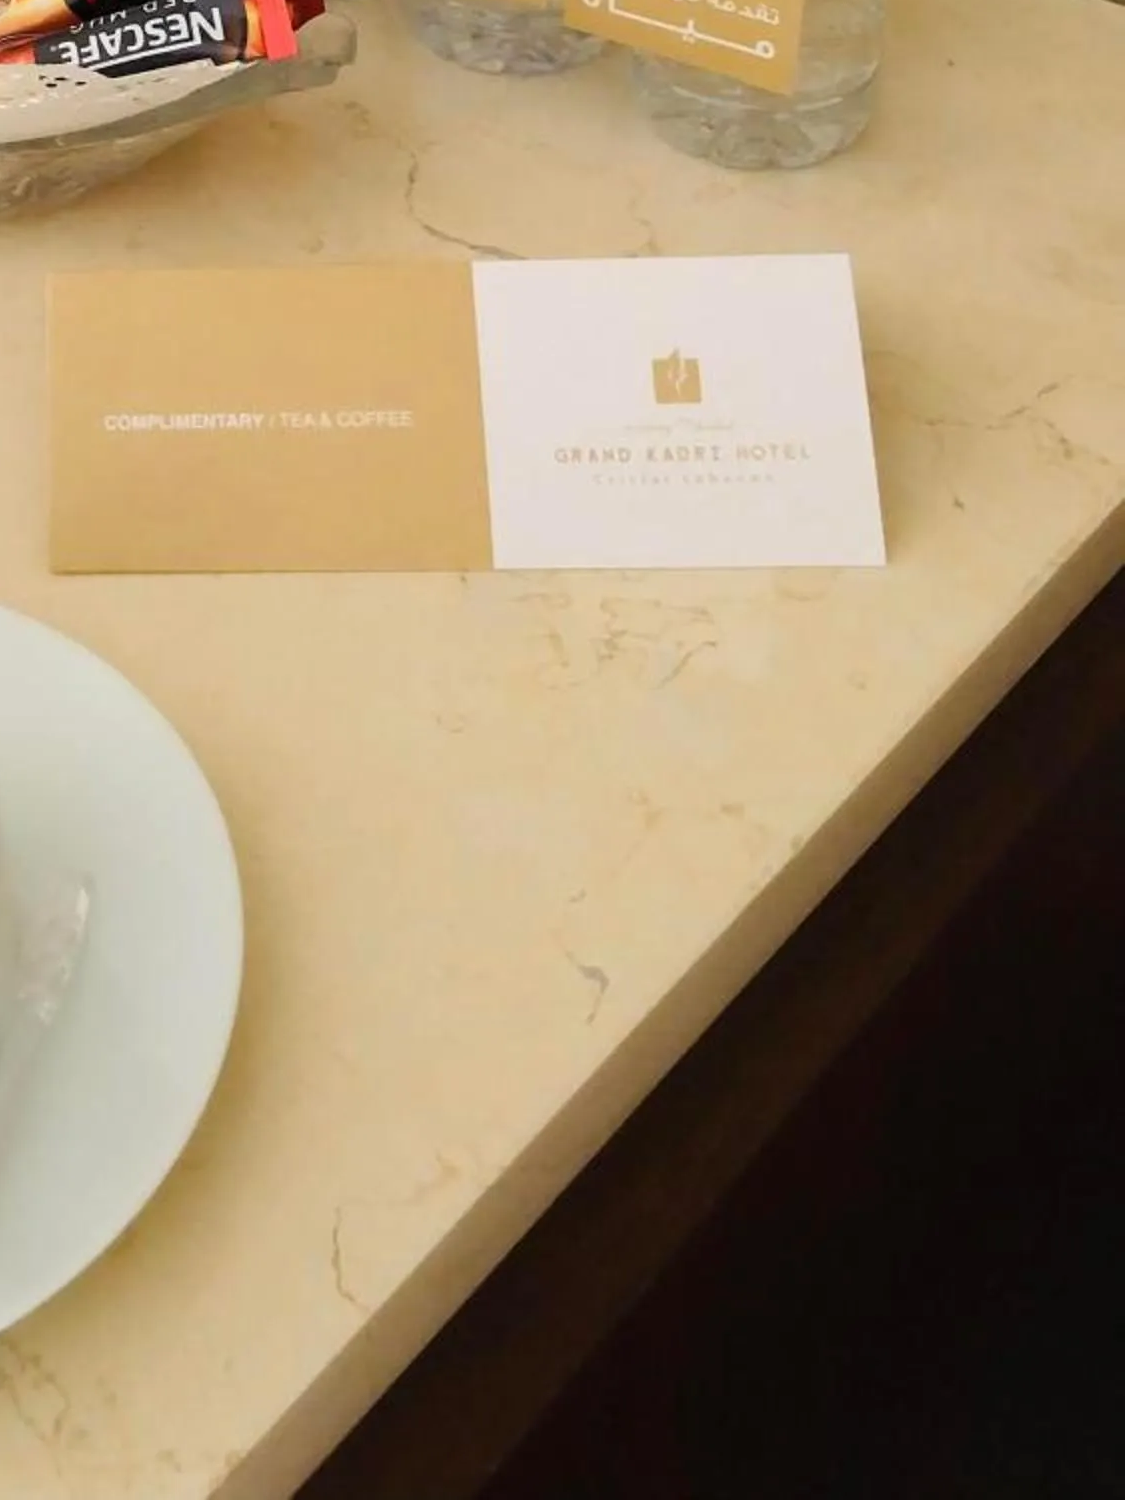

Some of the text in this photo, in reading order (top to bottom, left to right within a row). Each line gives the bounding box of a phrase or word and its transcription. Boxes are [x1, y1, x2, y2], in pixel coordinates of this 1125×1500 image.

[103, 412, 265, 432] COMPLIMENTARY
[279, 411, 316, 430] TEA
[335, 409, 414, 429] COFFEE
[553, 446, 633, 465] GRAND
[736, 441, 812, 462] HOTEL
